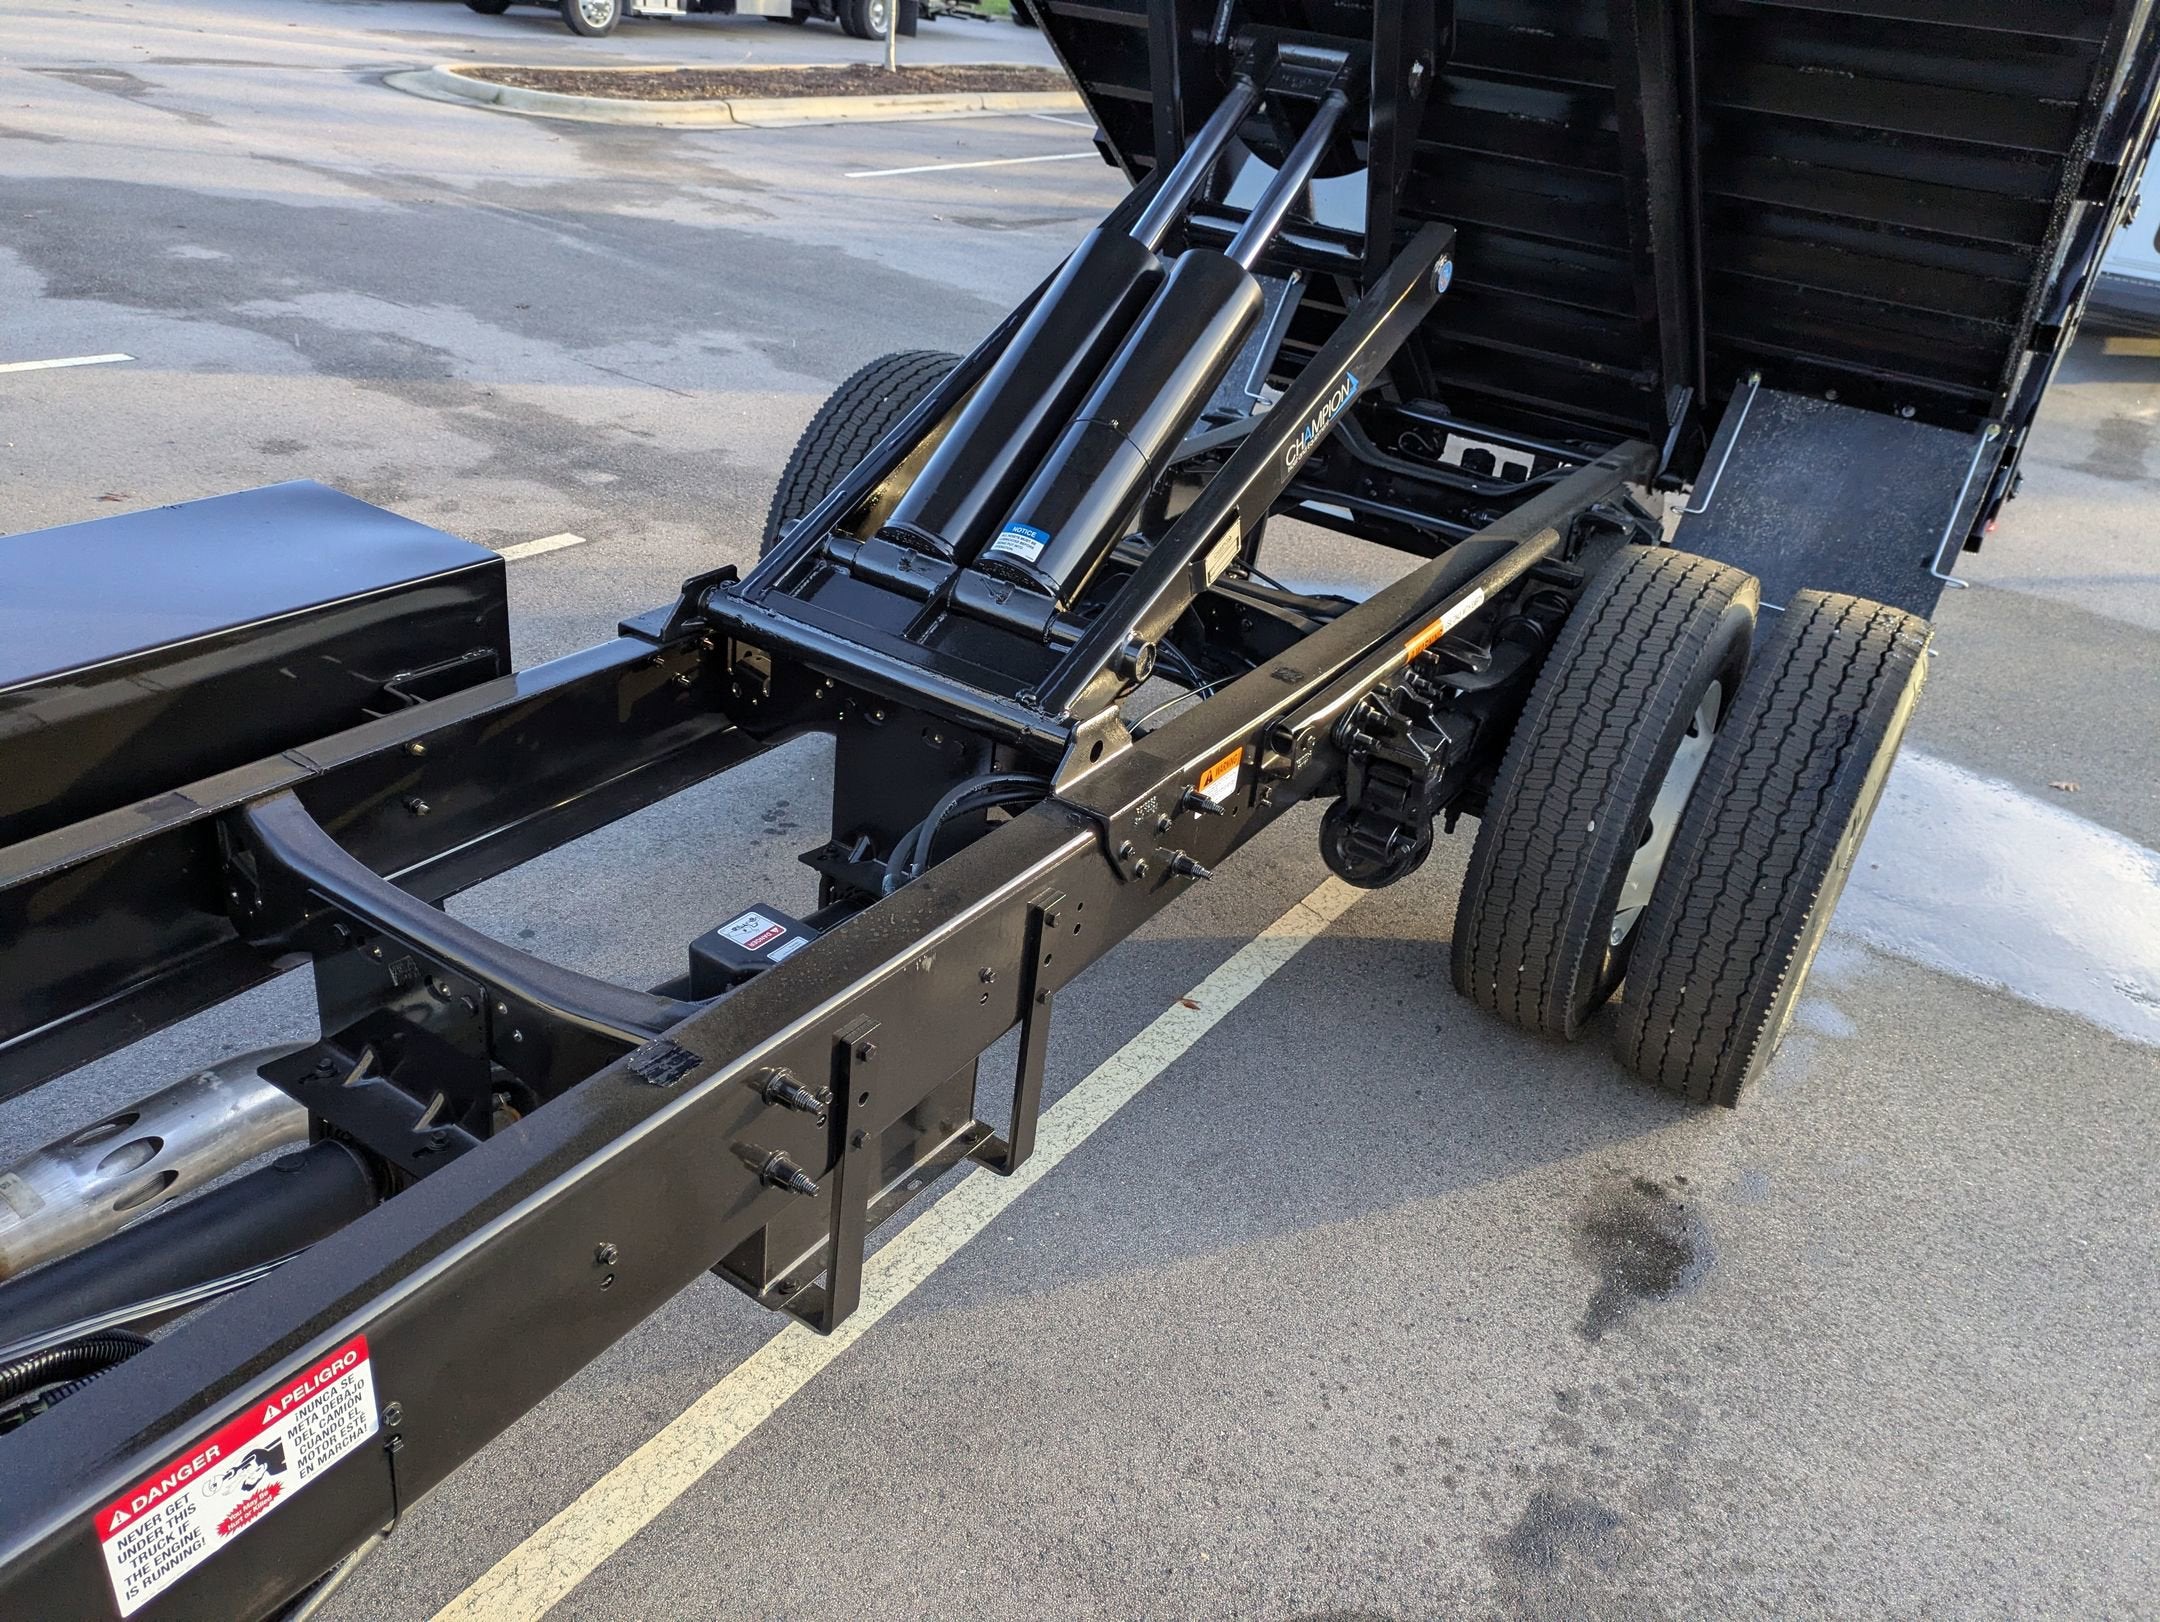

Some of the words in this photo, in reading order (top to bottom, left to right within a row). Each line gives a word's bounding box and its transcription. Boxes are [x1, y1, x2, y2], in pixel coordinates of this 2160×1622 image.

[1286, 378, 1350, 466] CHAMPION
[1012, 526, 1037, 538] NOTICE
[1215, 753, 1238, 778] WARNING
[748, 932, 772, 947] DANGER
[281, 1350, 357, 1410] PELIGRO
[295, 1387, 338, 1422] ¡NUNCA
[340, 1374, 355, 1389] SE
[287, 1412, 318, 1439] META
[322, 1379, 365, 1415] DEBAJO
[294, 1428, 316, 1446] DEL
[319, 1392, 362, 1429] CAMIÓN
[300, 1416, 345, 1455] CUANDO
[348, 1406, 361, 1420] EL
[298, 1436, 337, 1468] MOTOR
[340, 1412, 366, 1437] ESTÉ
[300, 1463, 314, 1479] EN
[318, 1423, 368, 1467] MARCHA!
[131, 1444, 221, 1513] DANGER
[117, 1513, 162, 1550] NEVER
[166, 1492, 190, 1517] GET
[117, 1526, 164, 1564] UNDER
[166, 1503, 197, 1528] THIS
[228, 1516, 244, 1530] Hurt
[244, 1510, 252, 1518] or
[253, 1494, 272, 1513] Killed
[229, 1510, 242, 1521] You
[243, 1499, 258, 1511] May
[124, 1563, 151, 1587] THE
[154, 1526, 202, 1566] ENGINE
[126, 1586, 139, 1601] IS
[142, 1537, 206, 1588] RUNNING!
[129, 1532, 175, 1569] TRUCK
[178, 1520, 190, 1535] IF
